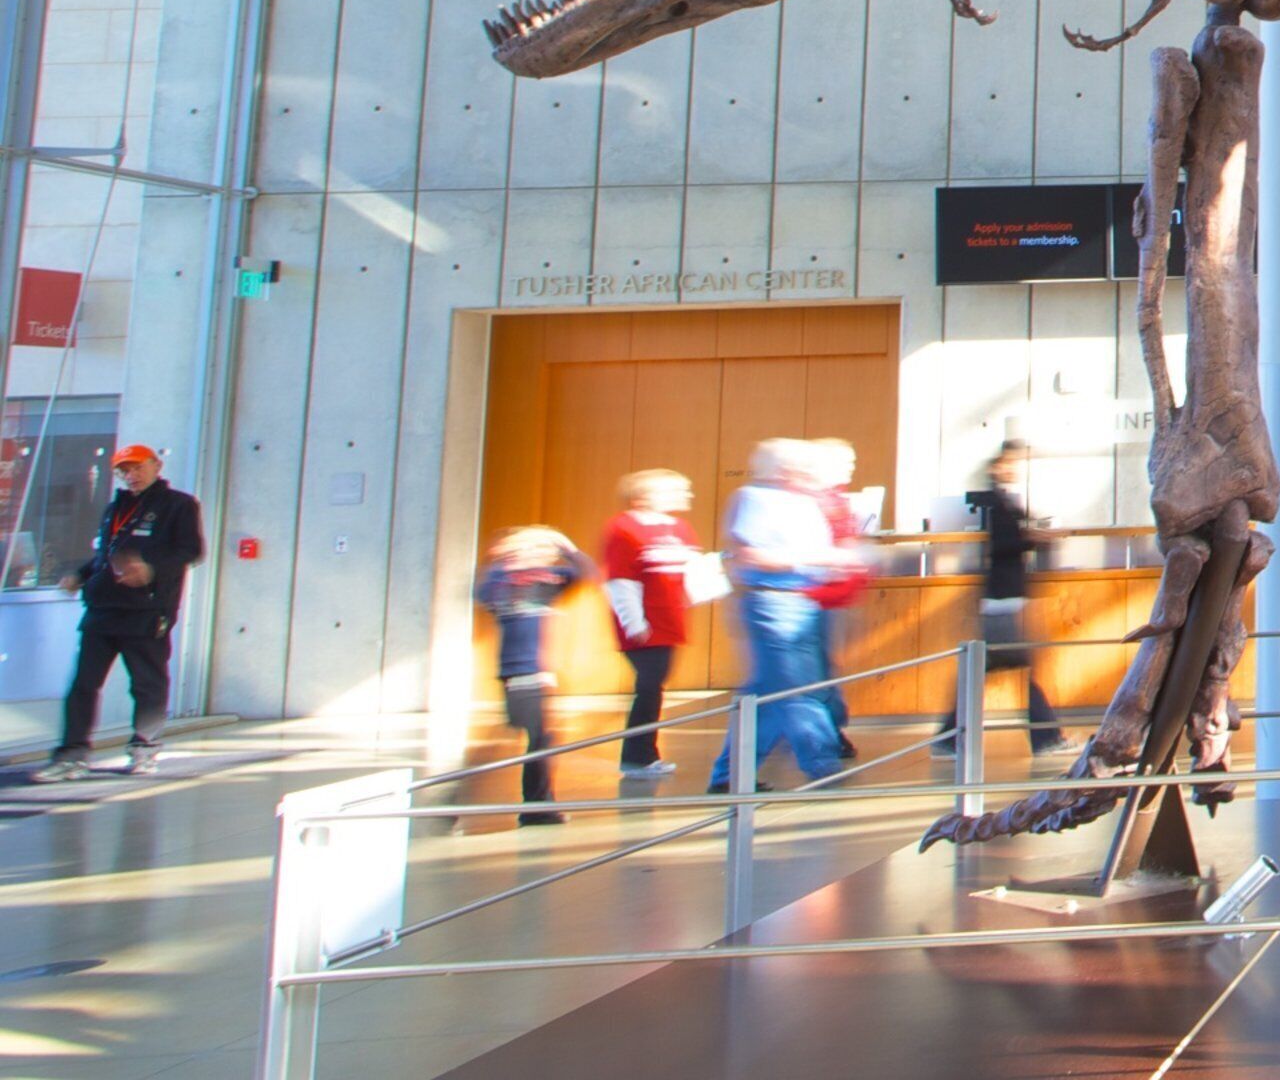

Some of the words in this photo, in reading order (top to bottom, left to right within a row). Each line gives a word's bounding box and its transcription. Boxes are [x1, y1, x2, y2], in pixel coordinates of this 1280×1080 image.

[973, 223, 1001, 234] Apply
[1003, 224, 1024, 234] your
[1026, 222, 1073, 232] admission
[966, 237, 997, 247] tickets
[1000, 237, 1009, 246] to
[1019, 235, 1080, 247] membership.
[511, 274, 615, 297] TUSHER
[621, 271, 737, 295] AFRICAN
[745, 269, 846, 291] CENTER
